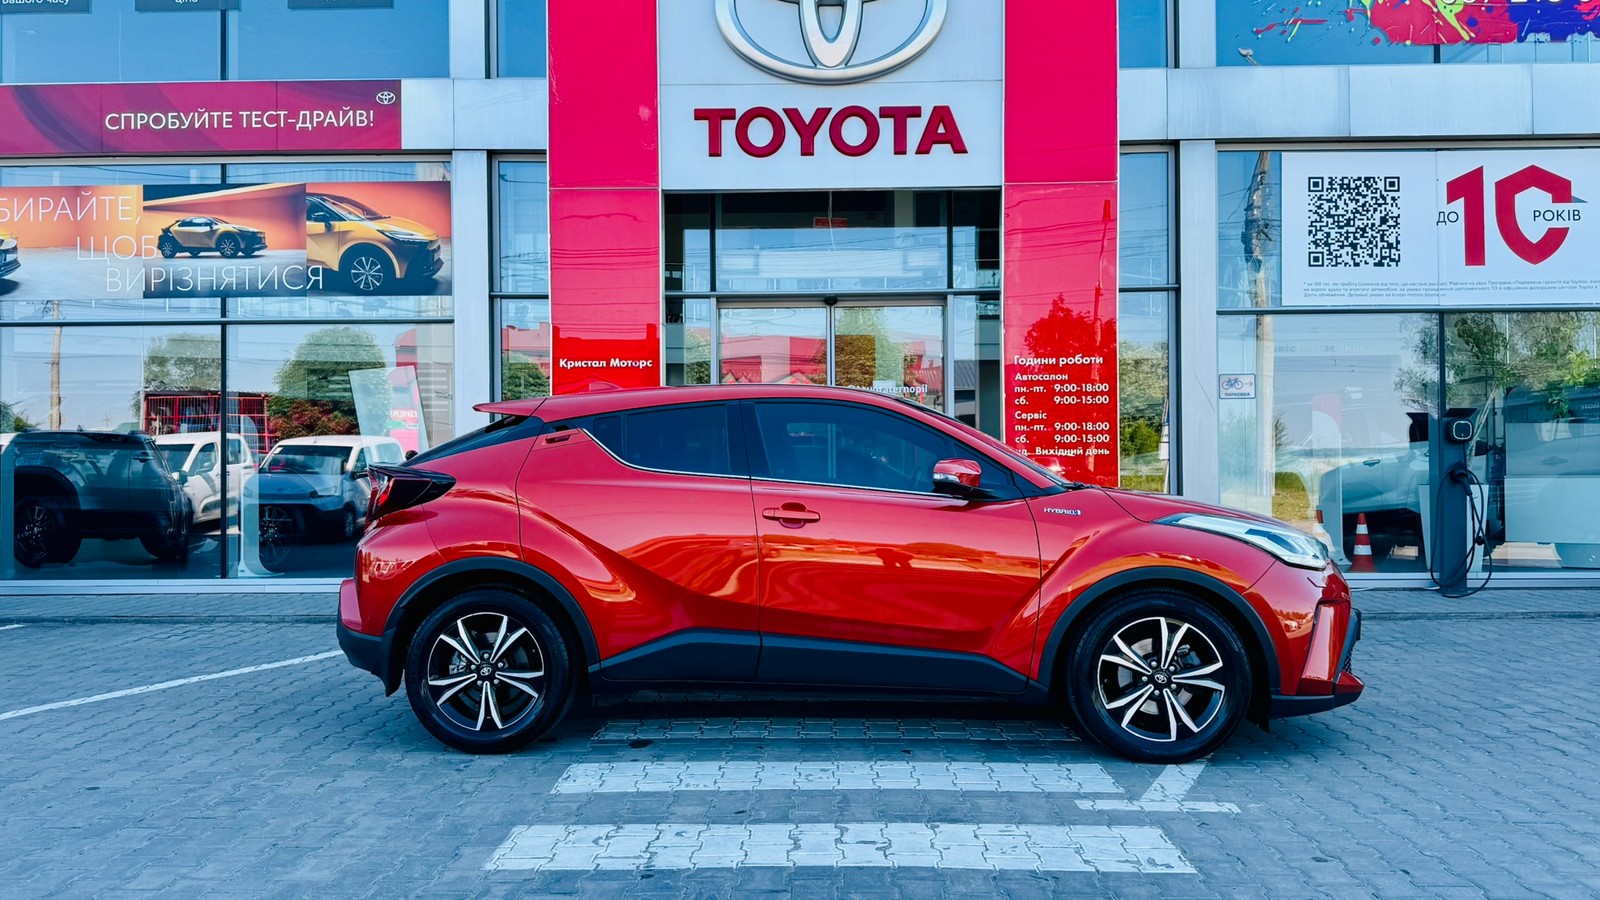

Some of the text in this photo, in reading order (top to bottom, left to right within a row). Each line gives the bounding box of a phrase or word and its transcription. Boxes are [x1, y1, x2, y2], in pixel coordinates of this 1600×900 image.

[105, 106, 374, 131] СПРОБУЙТЕ ТЕСТ-ДРАЙВ!
[694, 105, 969, 158] TOYOTA
[1436, 164, 1581, 266] ДО 10 РОКІВ
[76, 235, 157, 265] ЩОБ
[106, 265, 323, 292] ВИРІЗНЯТИСЯ
[559, 358, 652, 369] Кристал Моторс
[1014, 353, 1103, 367] Години роботи
[1015, 373, 1068, 381] Автосалон
[1053, 383, 1109, 392] 9:00-18:00
[1014, 395, 1109, 405] сб. 9:00-15:00
[1014, 410, 1047, 421] Сервіс
[1054, 422, 1109, 431] 9:00-18:00
[1015, 434, 1109, 443] сб. 9:00-15:00
[1035, 446, 1083, 456] Вихідний
[1085, 448, 1110, 456] день
[1043, 507, 1075, 515] HYBRID
